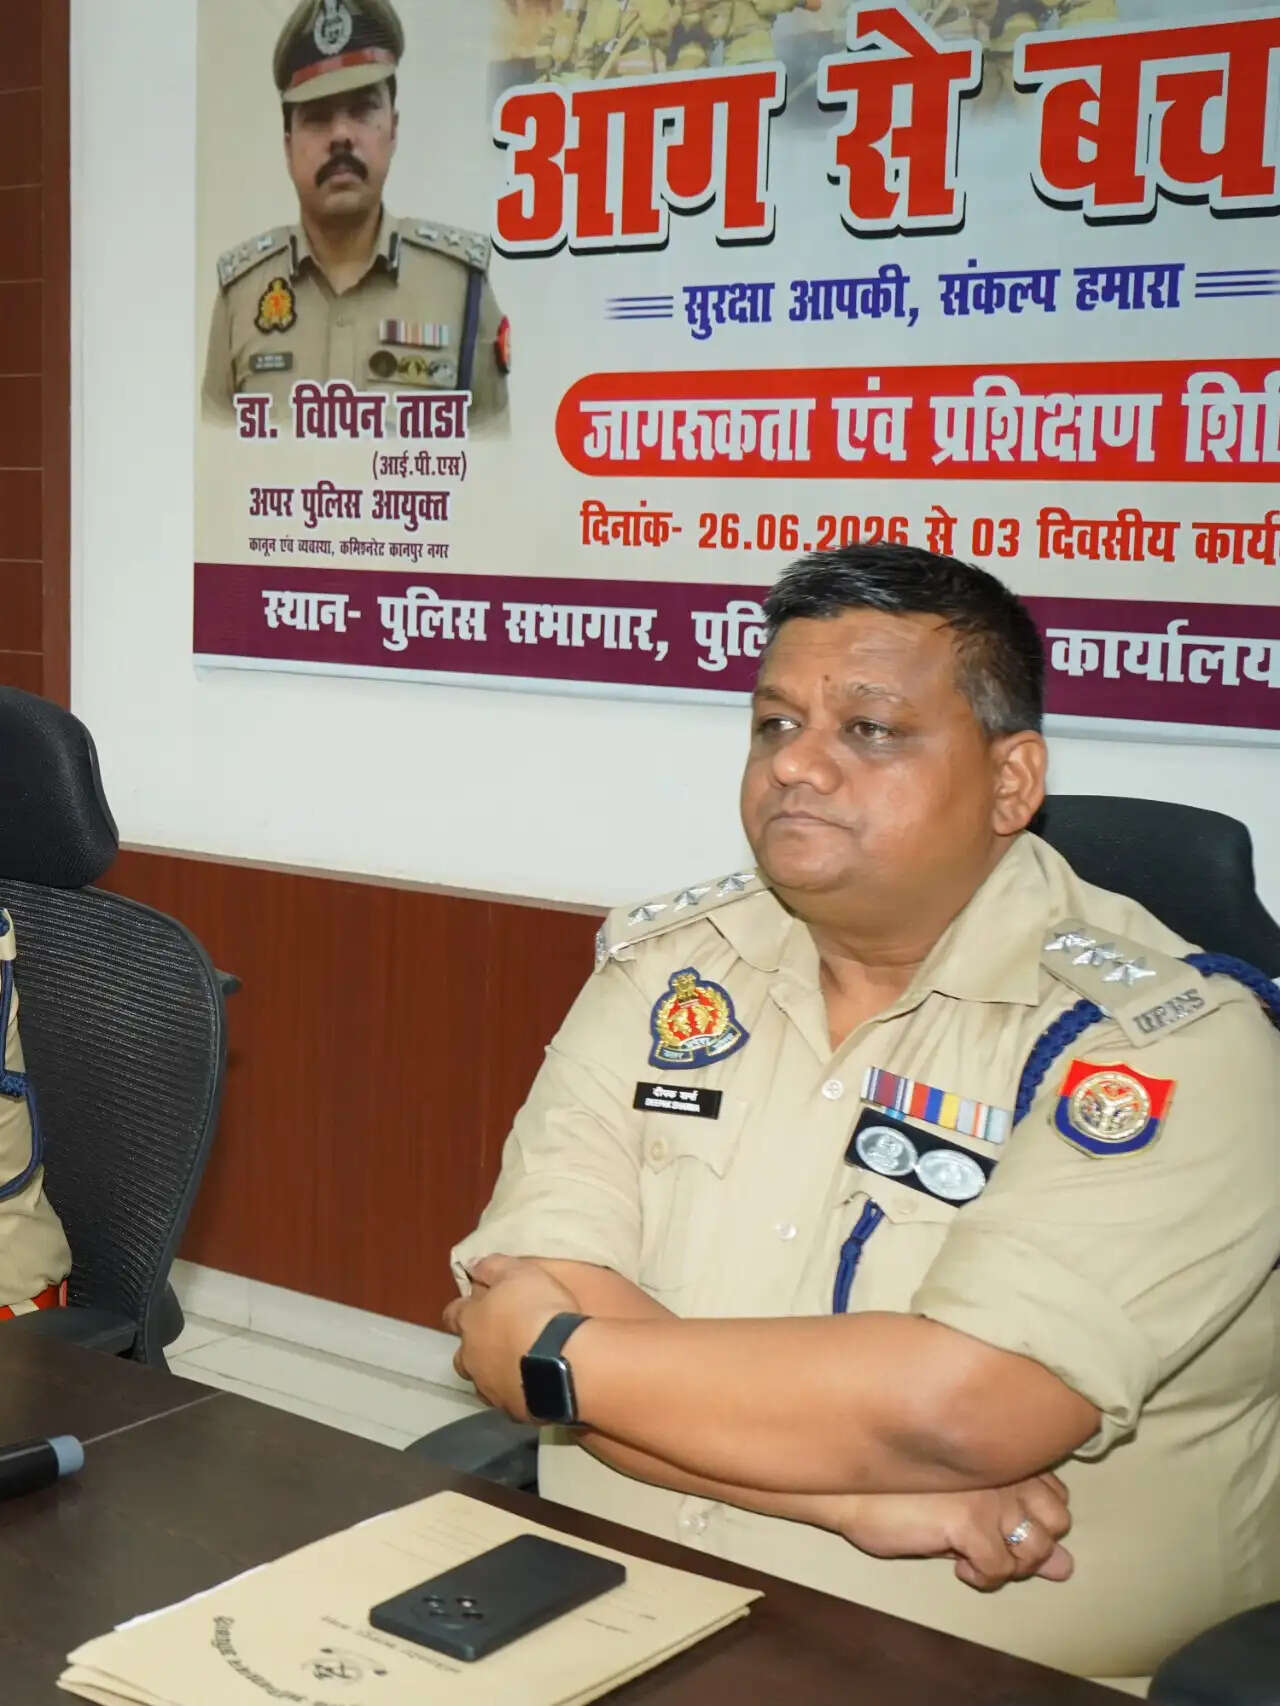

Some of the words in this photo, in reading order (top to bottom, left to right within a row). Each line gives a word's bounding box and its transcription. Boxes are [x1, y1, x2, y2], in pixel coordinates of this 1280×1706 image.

[495, 68, 778, 243] आग
[825, 6, 973, 220] से
[1022, 16, 1280, 208] बच
[682, 281, 776, 341] सुरक्षा
[788, 262, 920, 328] आपकी,
[937, 257, 1062, 316] संकल्प
[1072, 262, 1186, 312] हमारा
[291, 382, 388, 440] विपिन
[395, 393, 470, 440] ताडा
[929, 374, 1164, 467] प्रशिक्षण
[249, 486, 295, 518] अपर
[299, 479, 364, 530] पुलिस
[371, 488, 451, 533] आयुक्त
[697, 511, 910, 553] 26.06.2026
[923, 504, 959, 556] से
[971, 517, 1021, 558] 03
[1036, 506, 1182, 562] दिवसीय
[1191, 509, 1280, 566] कार्य
[248, 536, 277, 557] कानून
[388, 541, 424, 564] कानपुर
[426, 542, 451, 560] नगर
[376, 585, 491, 652] पुलिस
[501, 601, 670, 662] सभागार,
[690, 599, 770, 672] पुलि
[1045, 618, 1280, 689] कार्यालय
